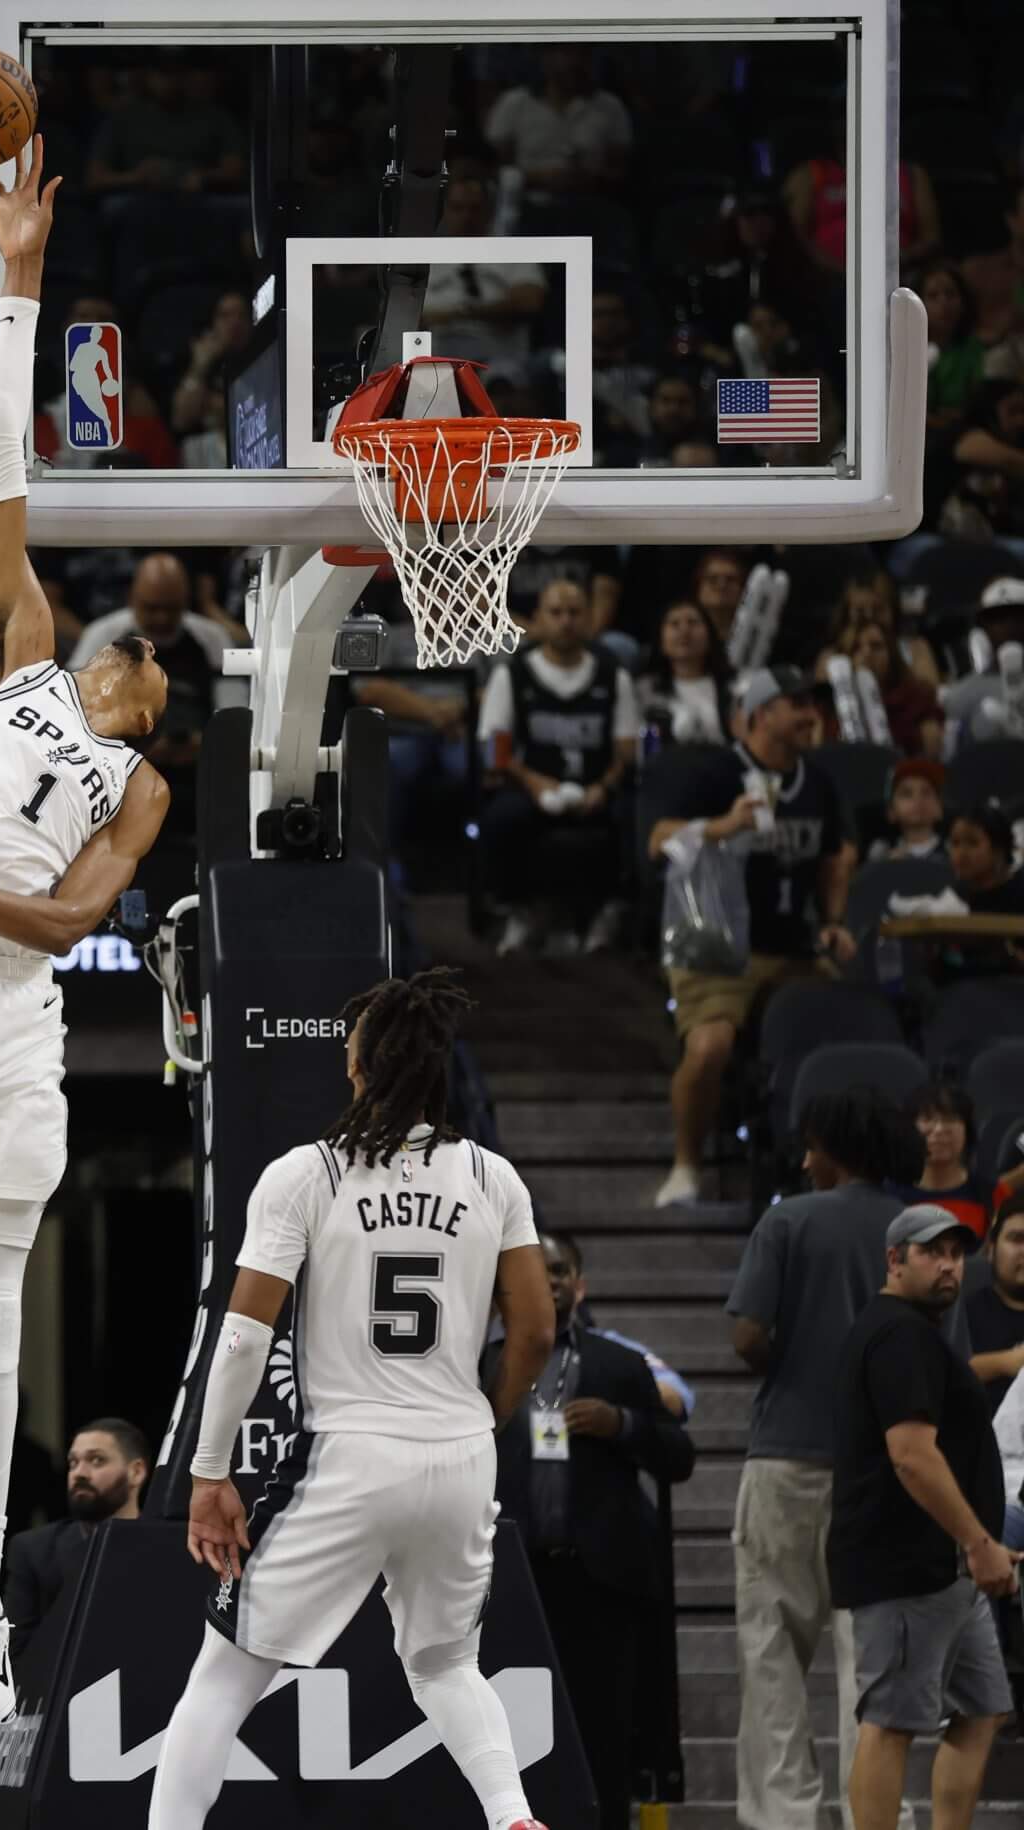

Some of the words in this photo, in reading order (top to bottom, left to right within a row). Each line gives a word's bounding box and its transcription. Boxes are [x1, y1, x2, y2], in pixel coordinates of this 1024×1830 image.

[75, 421, 102, 441] NBA
[19, 771, 59, 825] 1
[262, 1018, 347, 1038] LEDGER
[356, 1191, 468, 1238] CASTLE
[368, 1250, 445, 1360] 5
